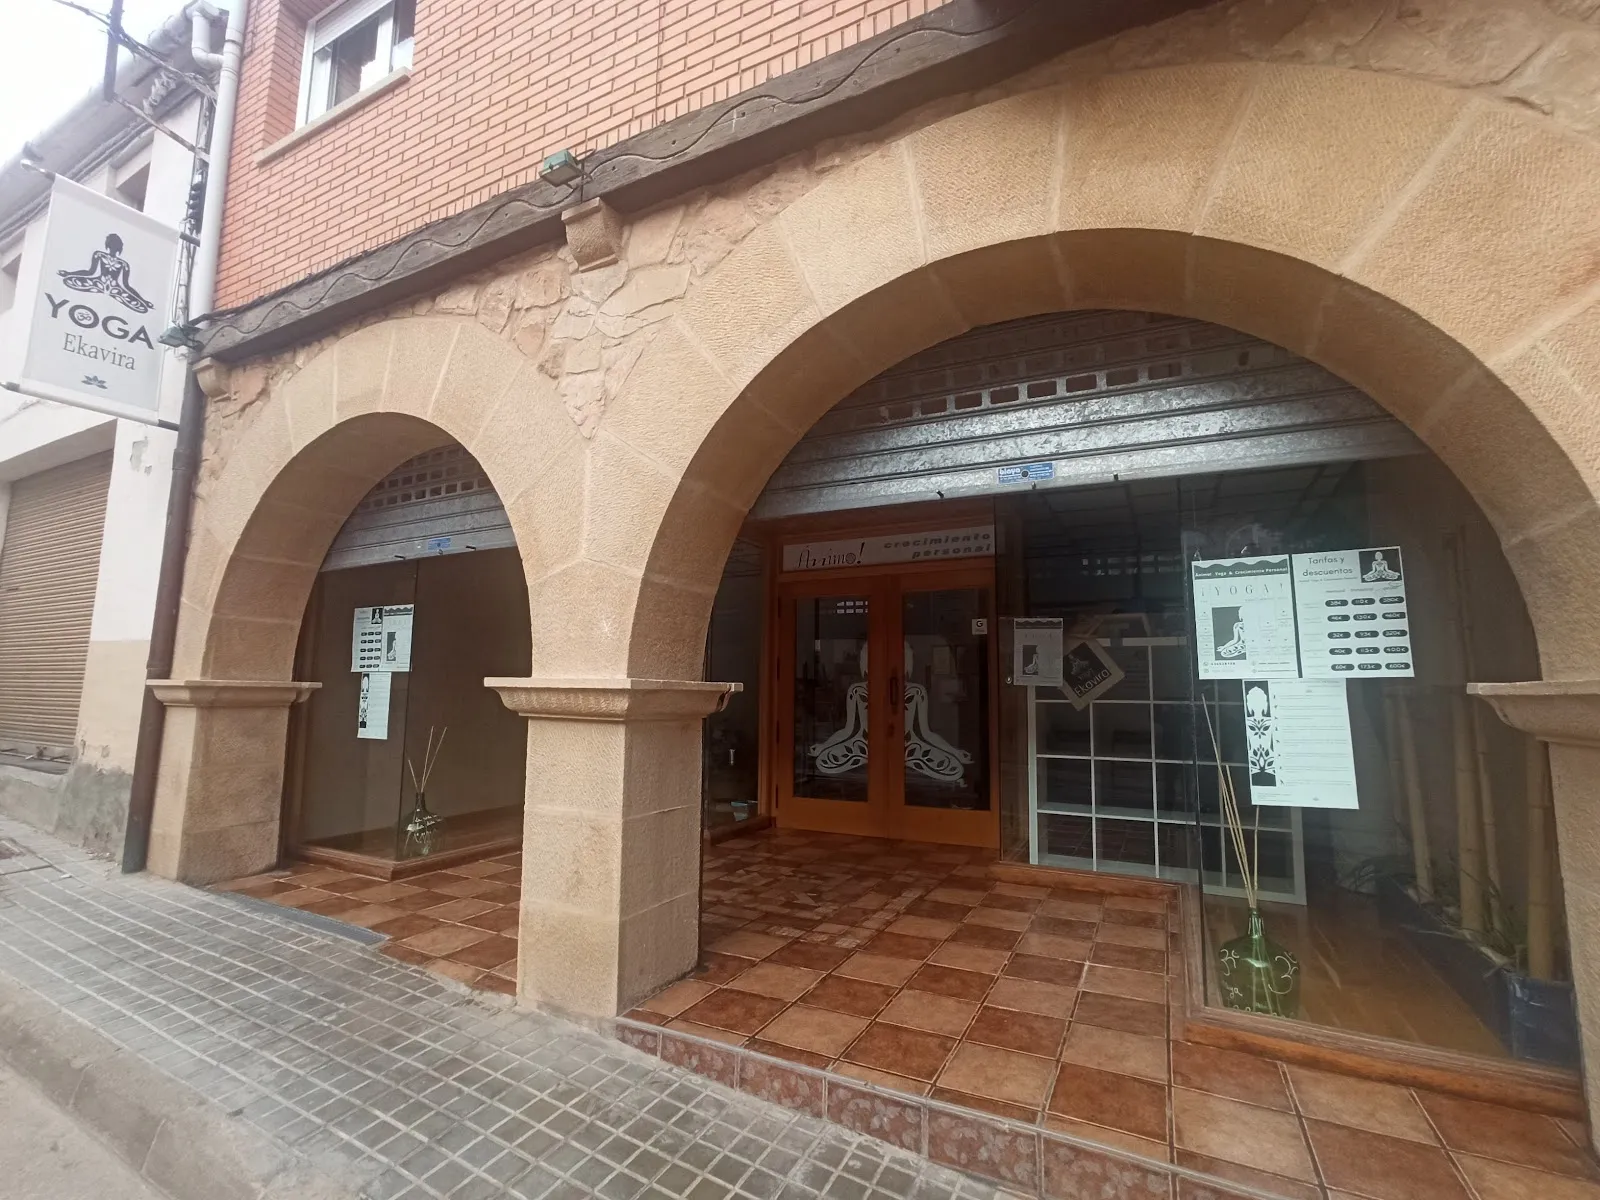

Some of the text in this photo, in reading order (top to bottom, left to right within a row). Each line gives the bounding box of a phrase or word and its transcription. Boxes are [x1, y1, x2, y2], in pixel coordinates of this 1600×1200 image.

[45, 292, 154, 350] YOGA
[63, 332, 135, 370] Ekavira
[884, 533, 990, 549] crecimiento
[912, 543, 991, 559] personal
[1308, 556, 1345, 565] Tarifas y
[1302, 567, 1353, 577] descuentos
